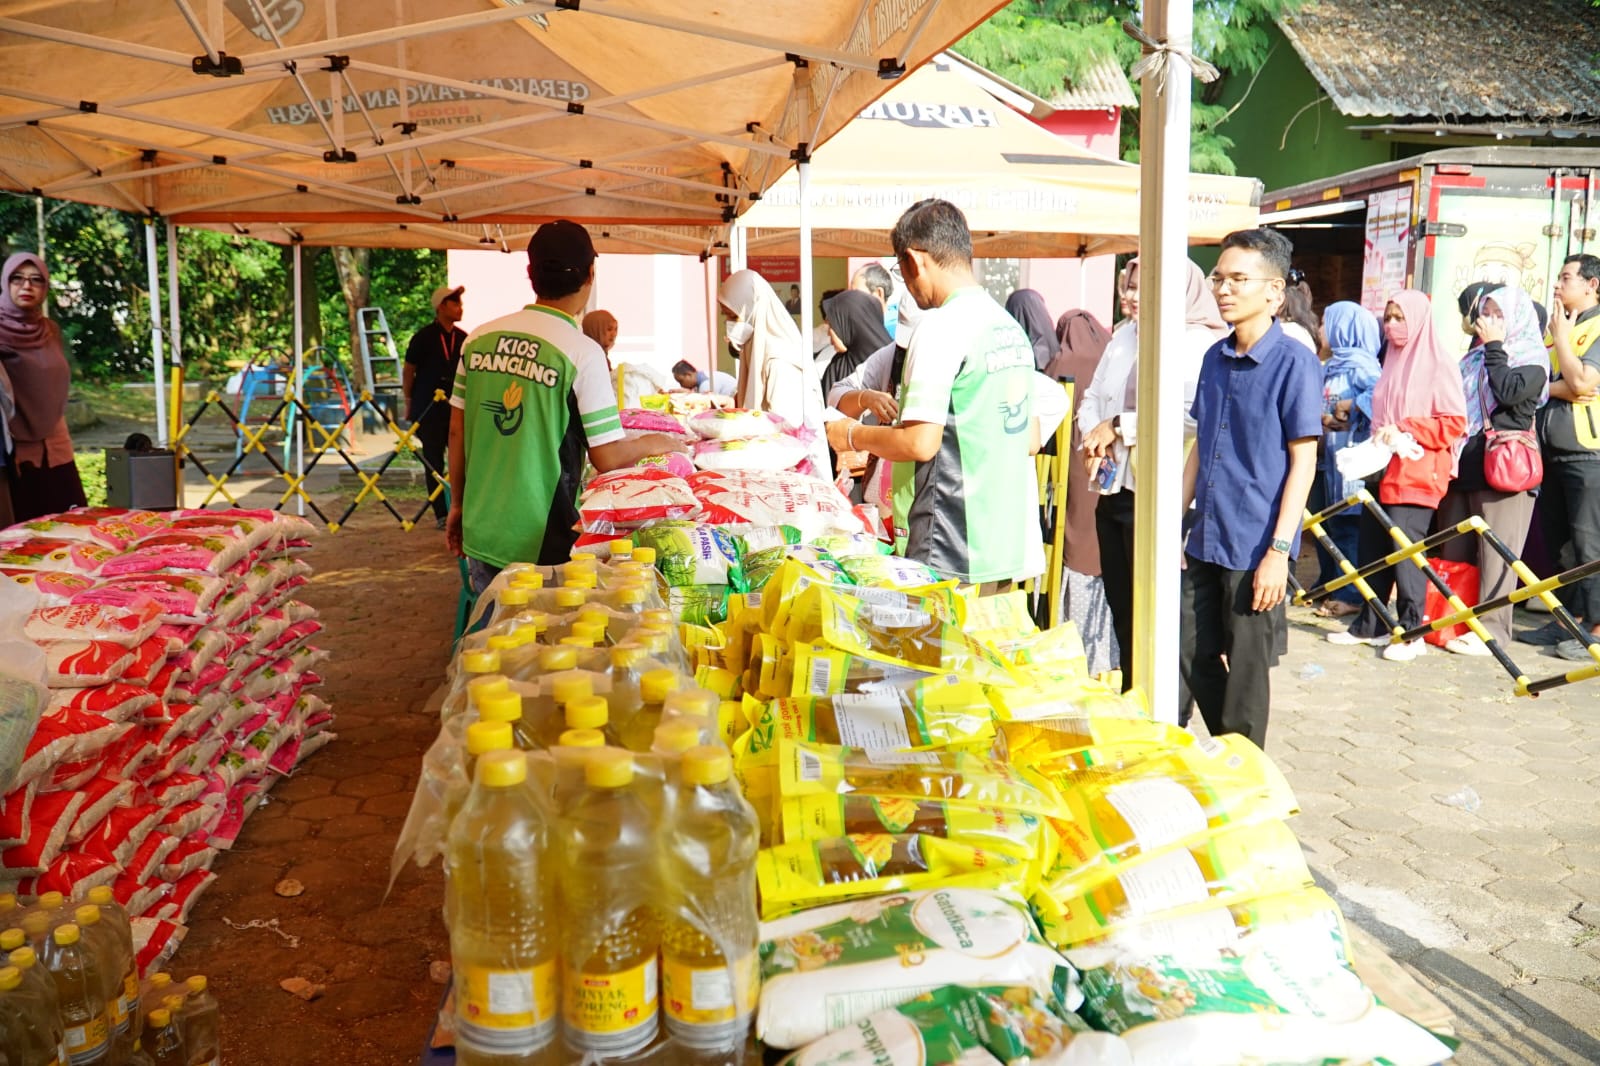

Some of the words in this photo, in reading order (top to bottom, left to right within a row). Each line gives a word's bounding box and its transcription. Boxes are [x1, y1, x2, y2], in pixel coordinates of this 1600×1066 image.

[857, 101, 1000, 129] MURAH
[497, 337, 540, 359] KIOS
[469, 352, 558, 387] PANGLING
[933, 892, 974, 949] Gatotkaca
